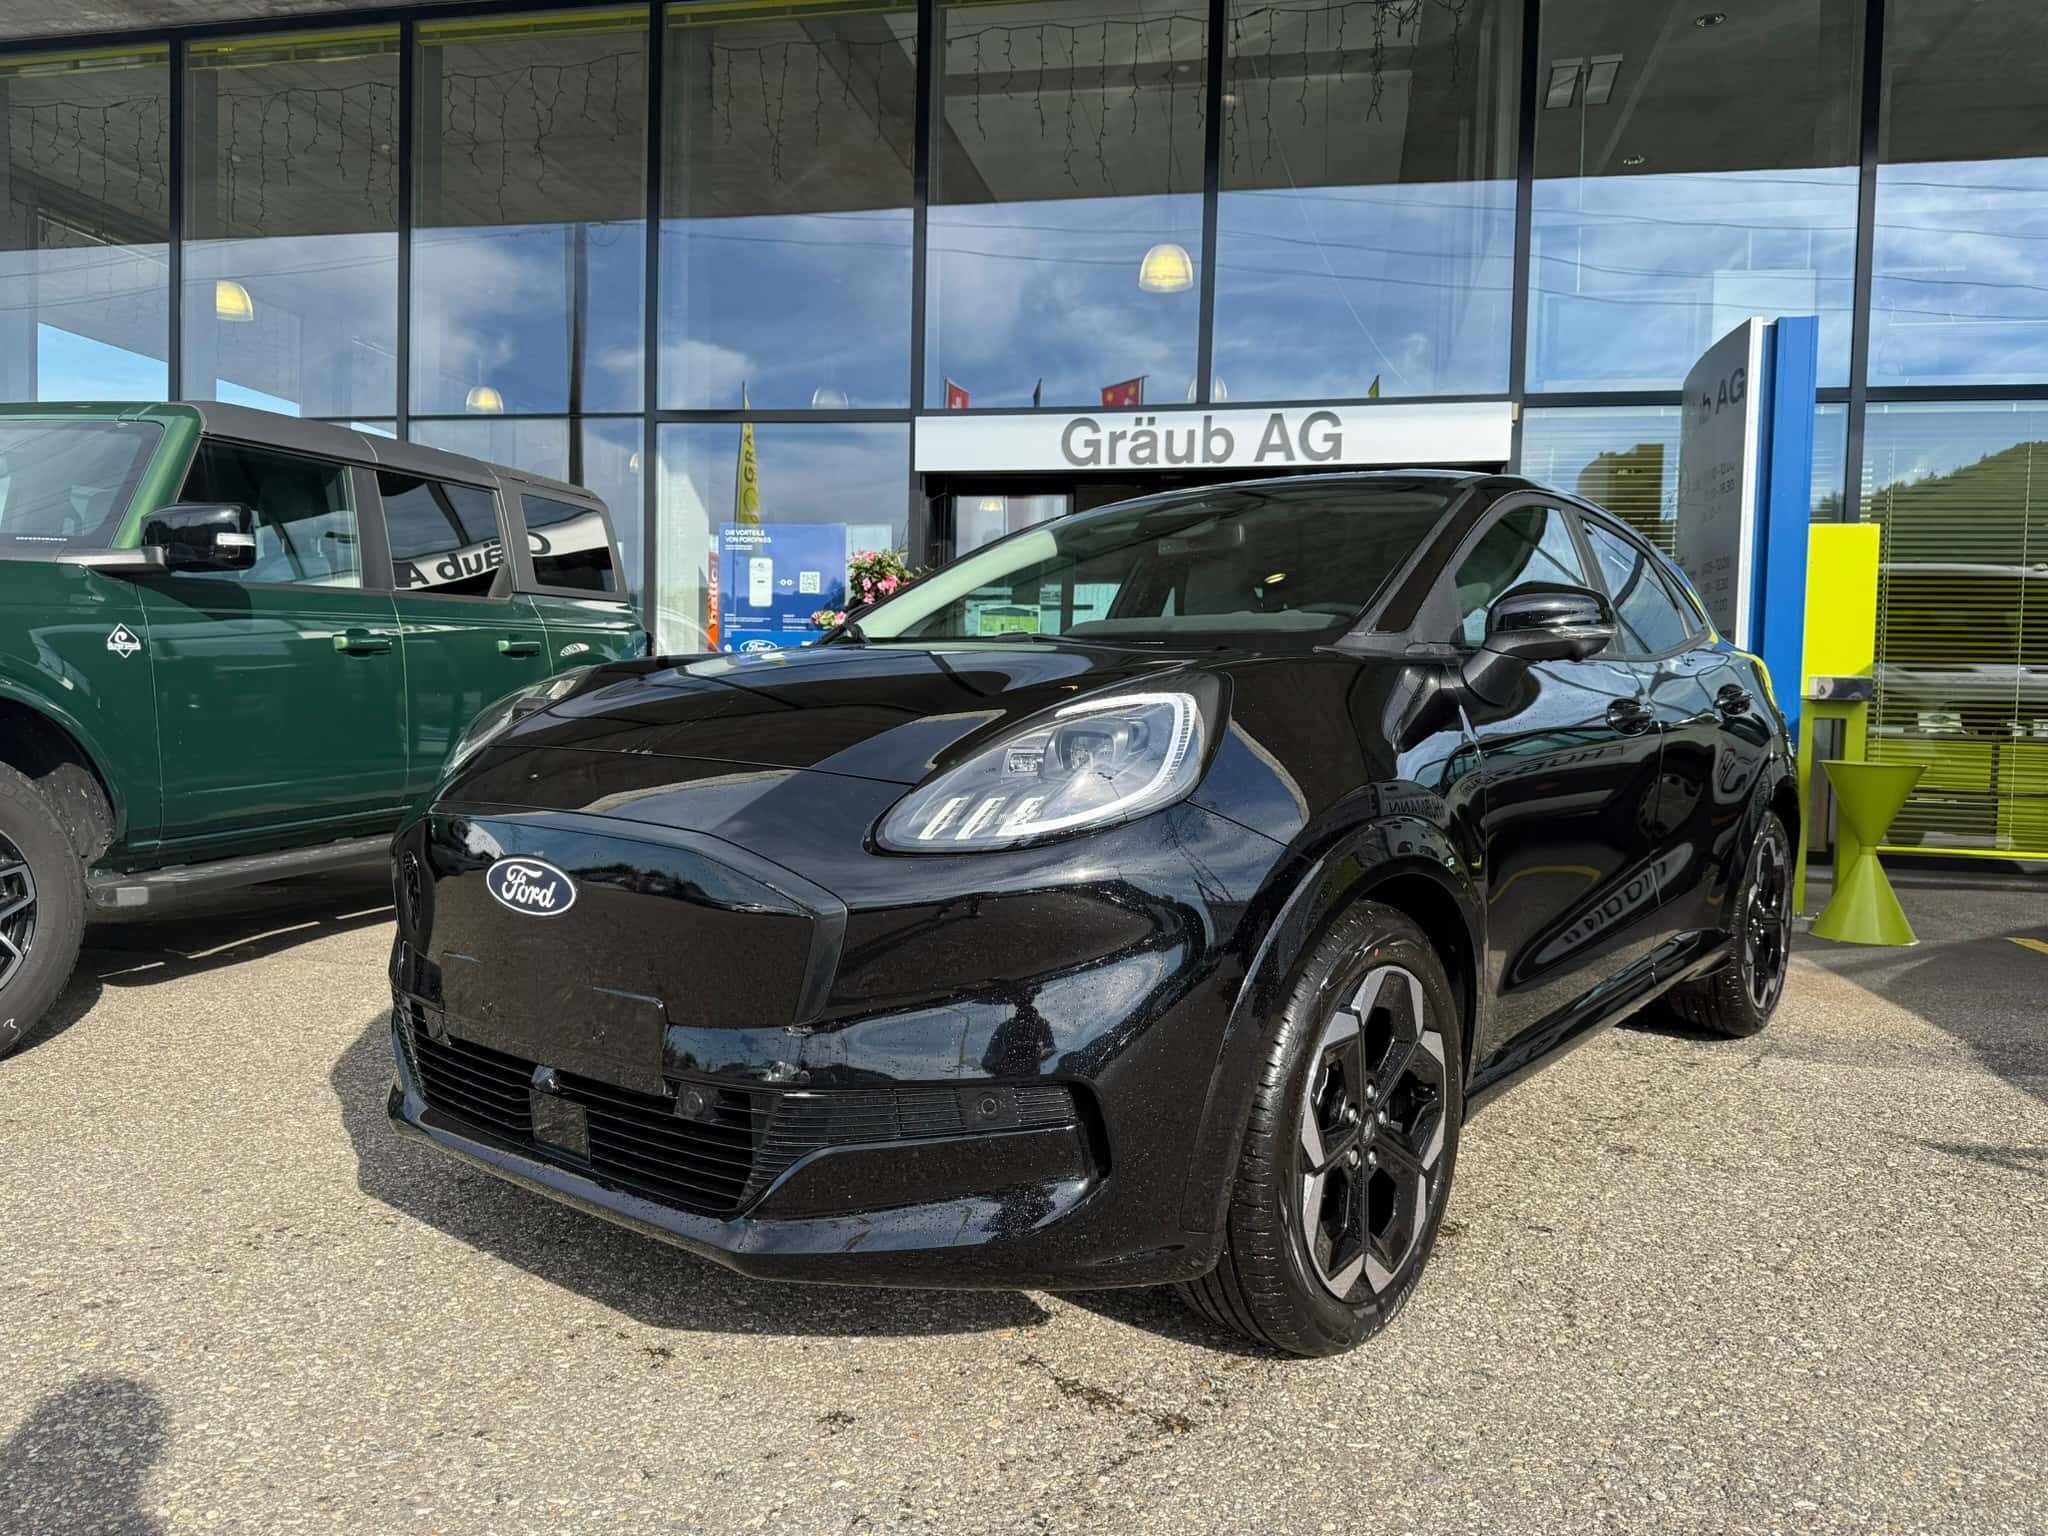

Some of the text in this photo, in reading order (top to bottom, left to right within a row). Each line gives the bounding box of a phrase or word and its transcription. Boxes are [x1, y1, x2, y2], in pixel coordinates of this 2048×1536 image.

[1061, 410, 1343, 467] Gräub AG
[501, 865, 556, 908] Ford
